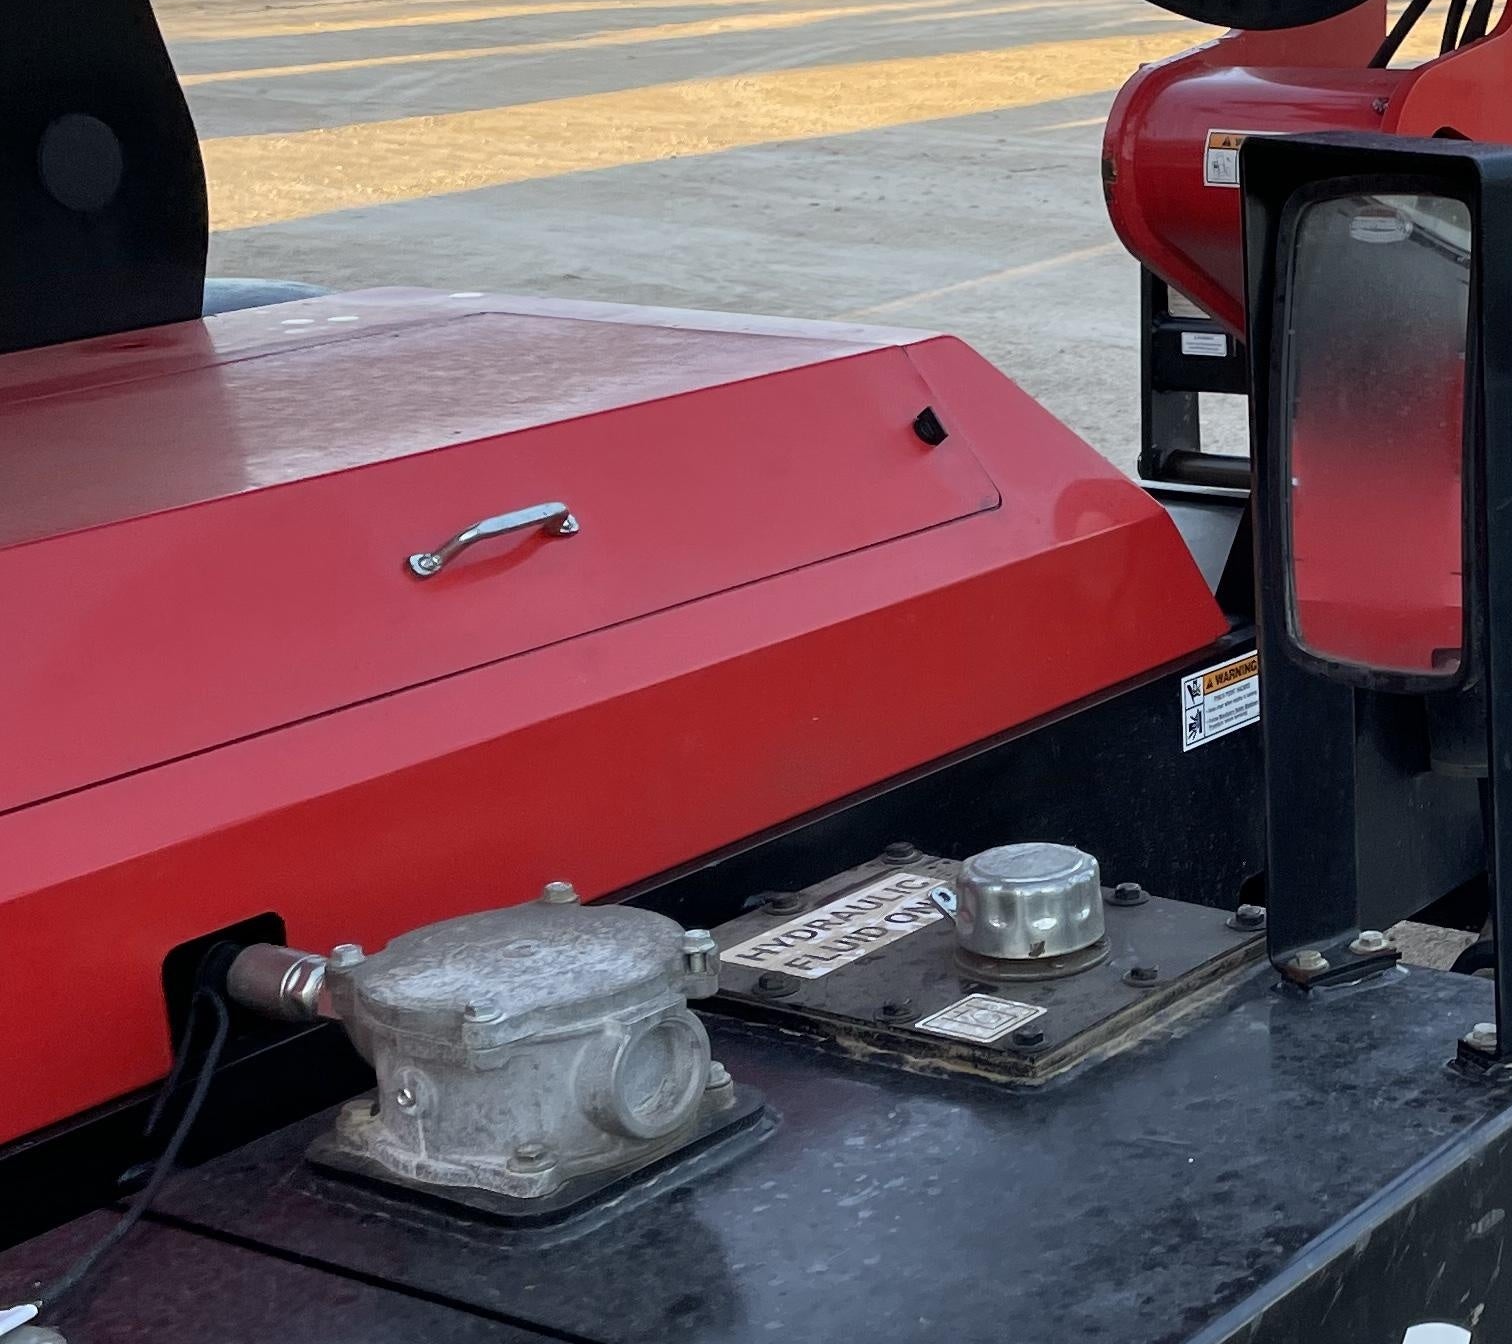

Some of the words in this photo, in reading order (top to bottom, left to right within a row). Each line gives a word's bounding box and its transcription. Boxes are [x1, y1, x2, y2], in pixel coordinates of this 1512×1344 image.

[1215, 659, 1258, 686] WARNING
[735, 878, 929, 962] HYDRAULIC
[784, 926, 889, 971] FLUID
[884, 895, 934, 924] ON
